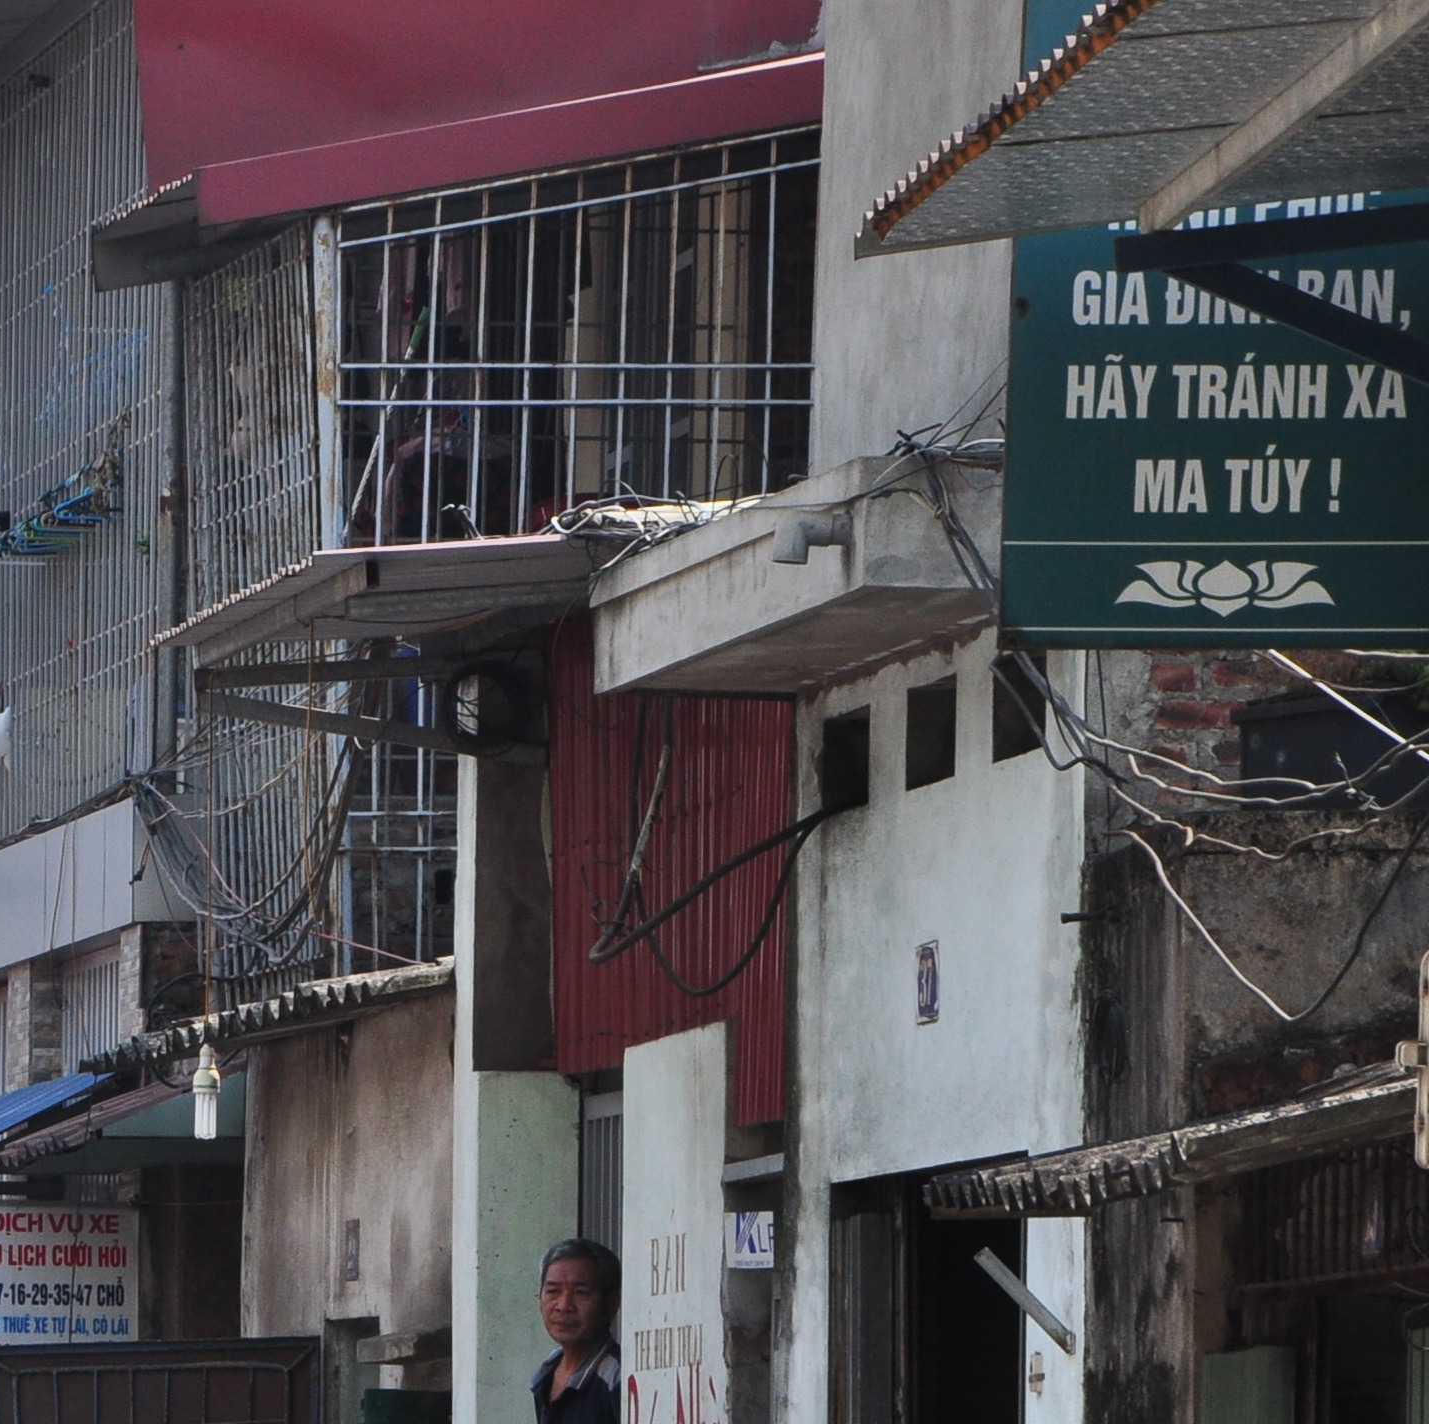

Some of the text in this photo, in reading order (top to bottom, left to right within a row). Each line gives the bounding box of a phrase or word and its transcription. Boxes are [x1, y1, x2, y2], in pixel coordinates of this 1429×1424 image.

[1072, 270, 1149, 325] GIA
[1065, 352, 1407, 419] HÃY TRÁNH XA
[1133, 445, 1342, 513] MA TÚY !
[48, 1213, 84, 1236] VỤ
[90, 1214, 119, 1234] XE
[8, 1244, 46, 1271] LỊCH
[52, 1241, 93, 1267] CƯỚI
[98, 1239, 127, 1268] HỎI
[97, 1276, 124, 1307] CHỖ
[3, 1314, 30, 1333] THUÊ
[34, 1317, 48, 1334] XE
[52, 1316, 67, 1337] TỰ
[93, 1314, 108, 1335] CÓ
[111, 1314, 129, 1335] LÁI
